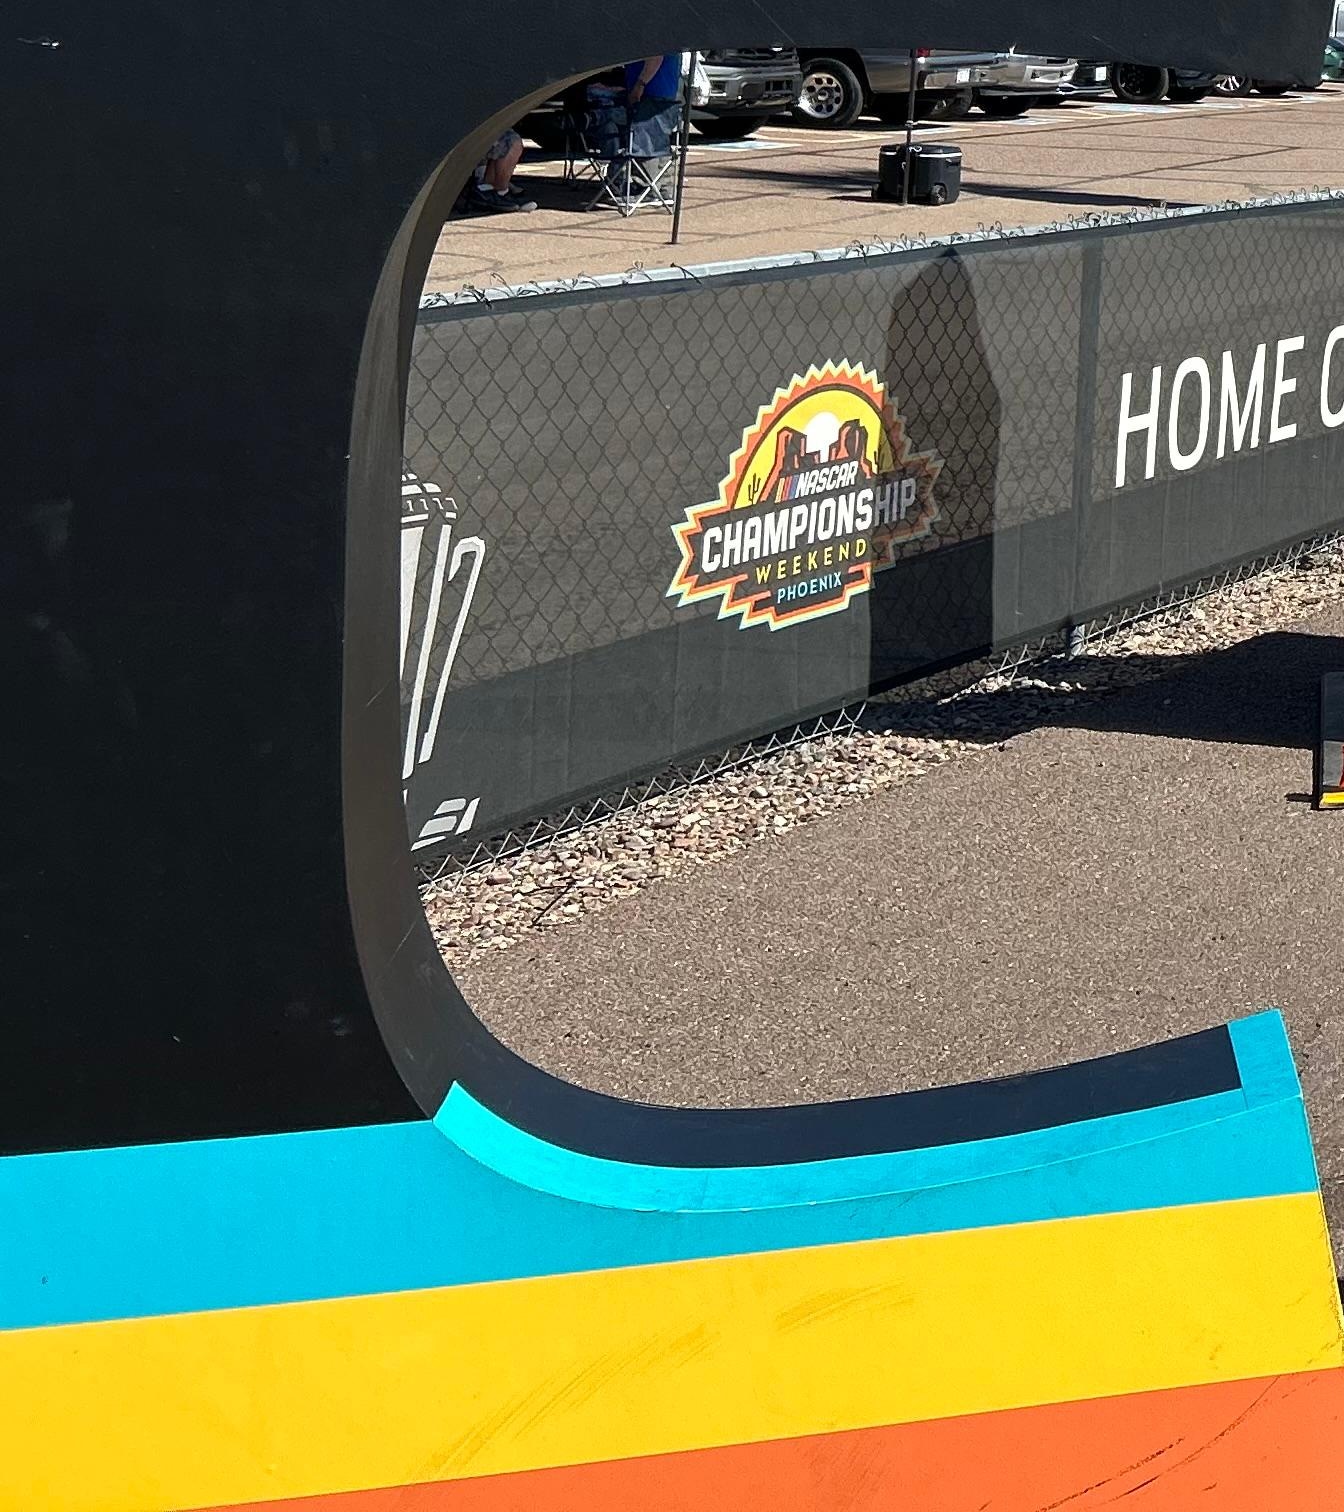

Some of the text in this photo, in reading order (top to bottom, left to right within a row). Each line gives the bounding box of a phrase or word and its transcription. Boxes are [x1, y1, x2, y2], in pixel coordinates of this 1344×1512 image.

[1115, 335, 1305, 489] HOME
[795, 460, 859, 499] NASCAR
[701, 477, 917, 574] CHAMPIONSHIP
[756, 537, 868, 585] WEEKEND
[777, 571, 843, 604] PHOENIX
